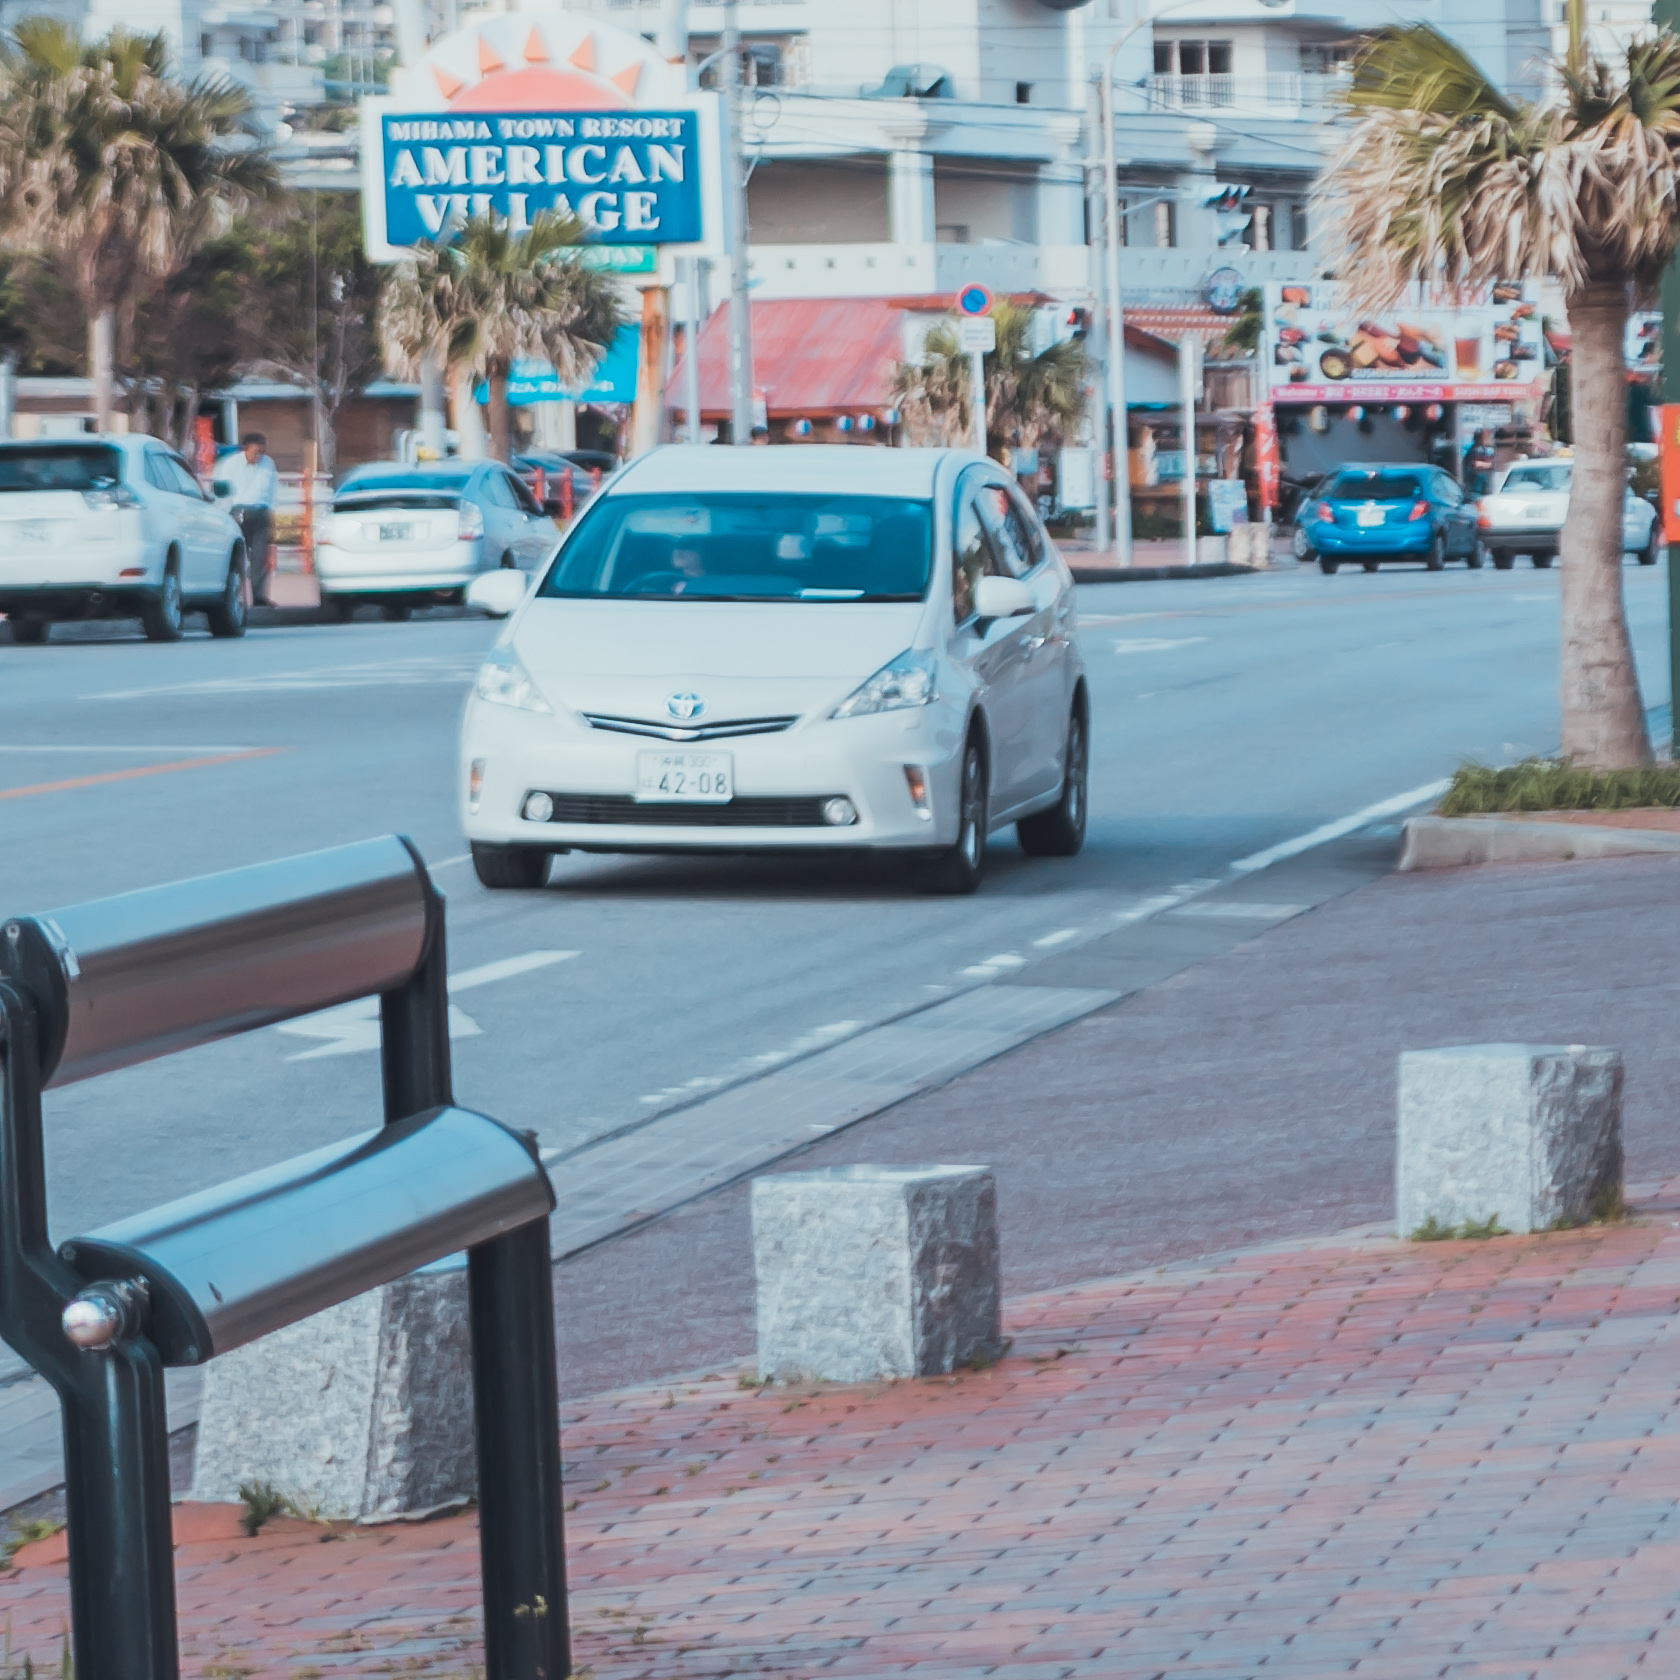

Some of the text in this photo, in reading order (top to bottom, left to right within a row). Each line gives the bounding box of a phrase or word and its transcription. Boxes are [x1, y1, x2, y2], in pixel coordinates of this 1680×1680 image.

[388, 118, 685, 141] MIHAMA TOWN RESORT
[389, 143, 686, 187] AMERICAN
[658, 772, 727, 795] 42-08
